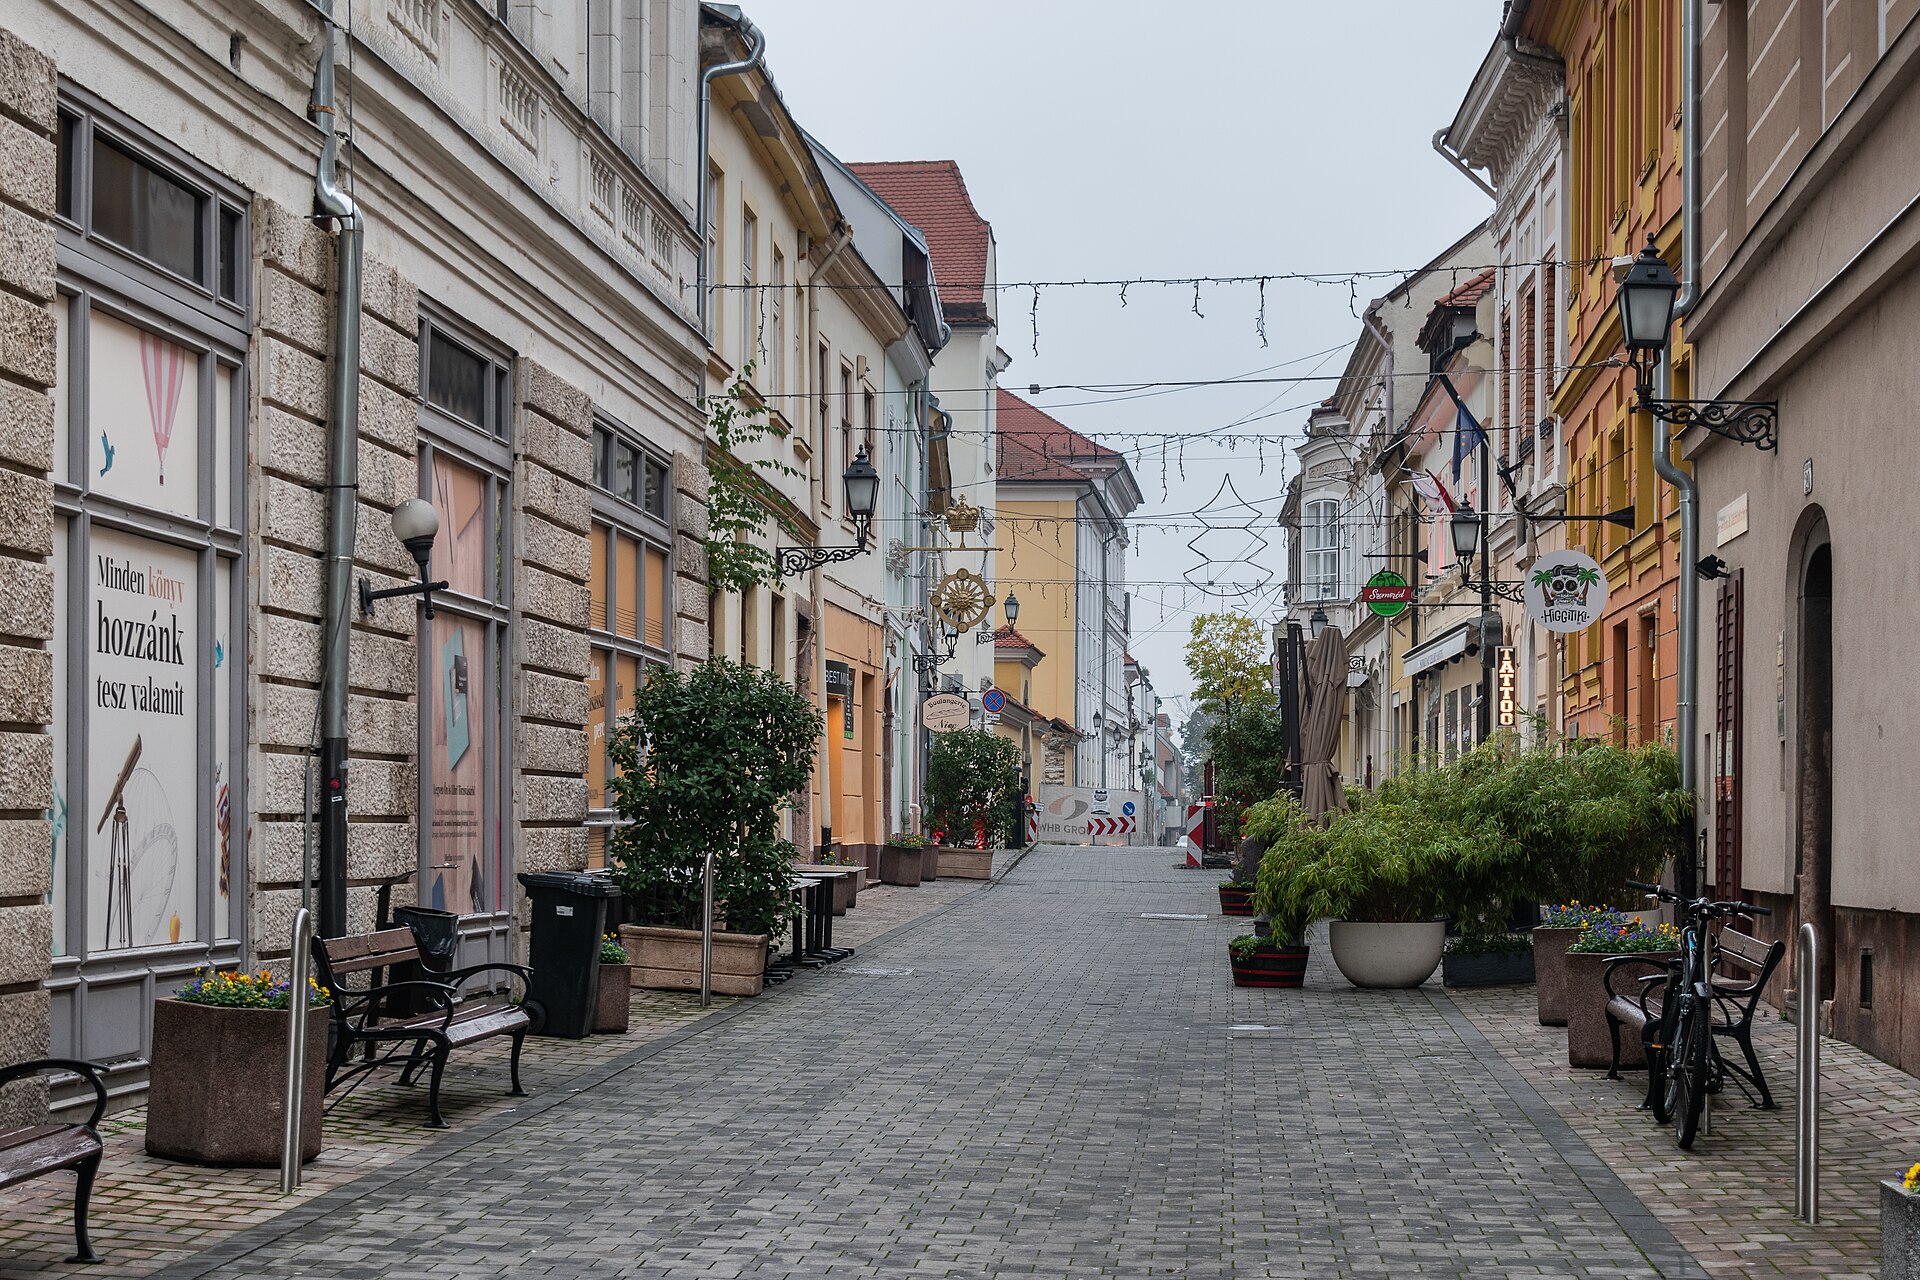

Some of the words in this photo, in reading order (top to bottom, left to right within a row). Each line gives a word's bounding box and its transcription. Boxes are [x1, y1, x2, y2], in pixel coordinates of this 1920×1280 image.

[98, 555, 145, 594] Minden
[148, 566, 184, 609] könyv
[97, 600, 184, 665] hozzánk
[97, 674, 126, 709] tesz
[131, 676, 184, 716] valamit
[825, 670, 840, 684] BEST
[1499, 648, 1515, 725] TATTOO
[927, 697, 967, 709] Boulangerie
[1040, 823, 1060, 833] WHB
[1063, 825, 1088, 835] GRO
